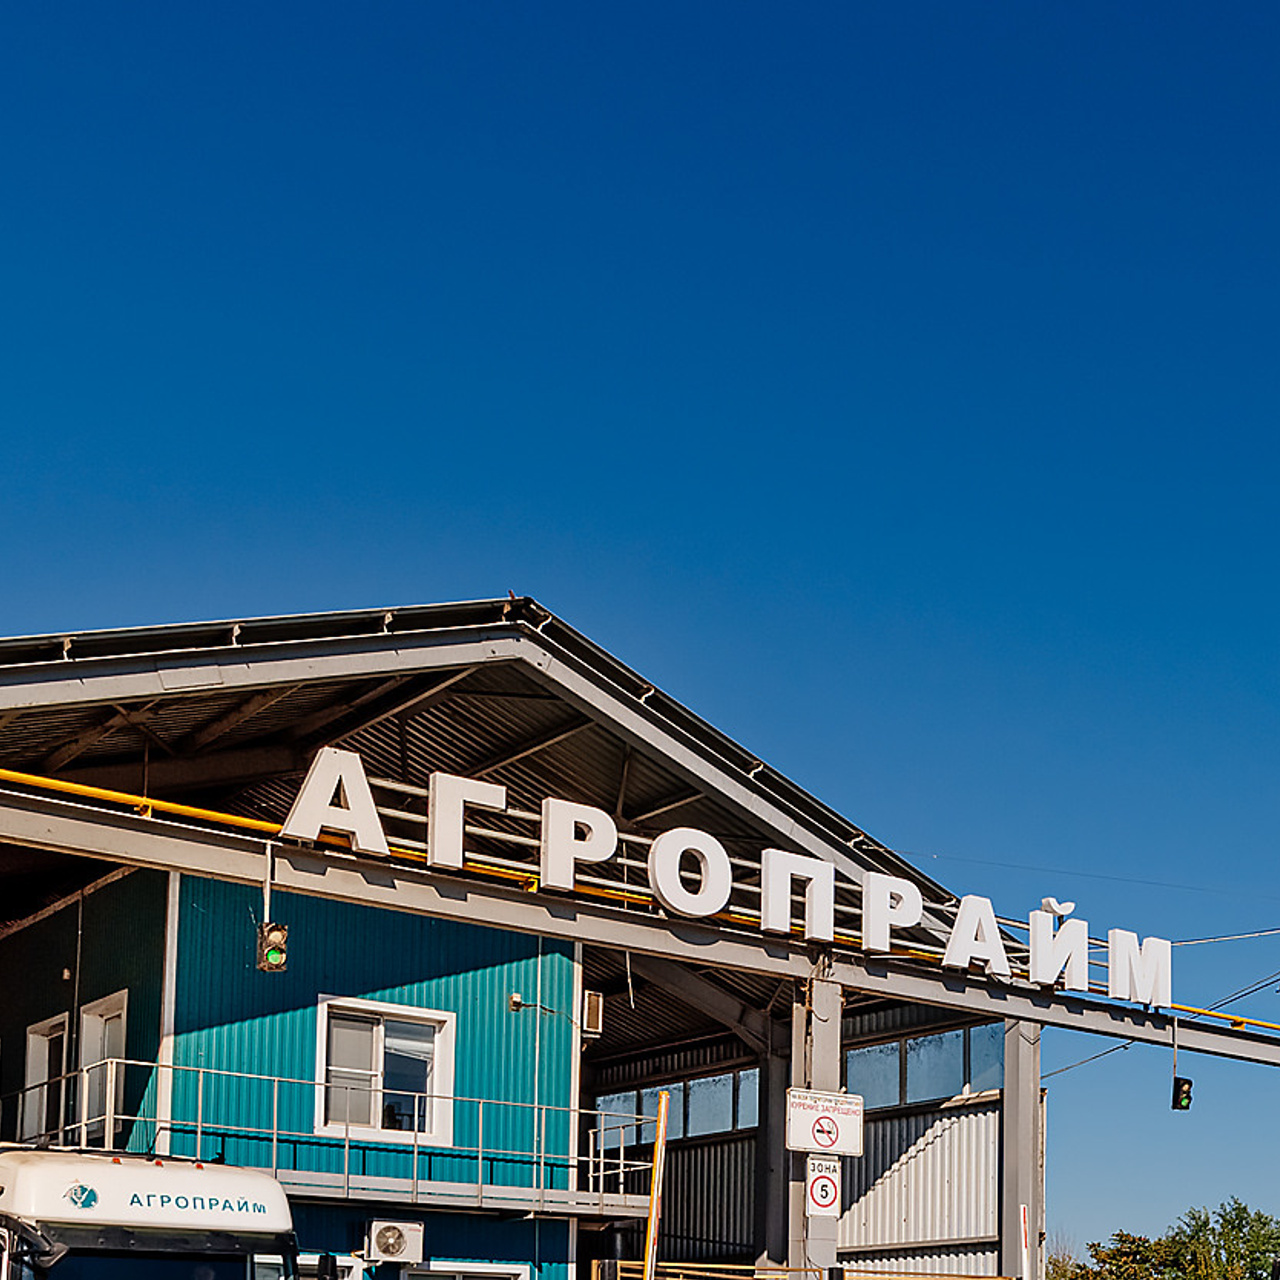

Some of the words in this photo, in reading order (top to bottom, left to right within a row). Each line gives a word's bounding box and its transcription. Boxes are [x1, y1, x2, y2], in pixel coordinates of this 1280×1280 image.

[282, 746, 1172, 1008] АГРОПРАЙМ
[810, 1162, 838, 1173] ЗОНА
[820, 1184, 829, 1199] 5
[129, 1193, 267, 1214] АГРОПРАЙМ
